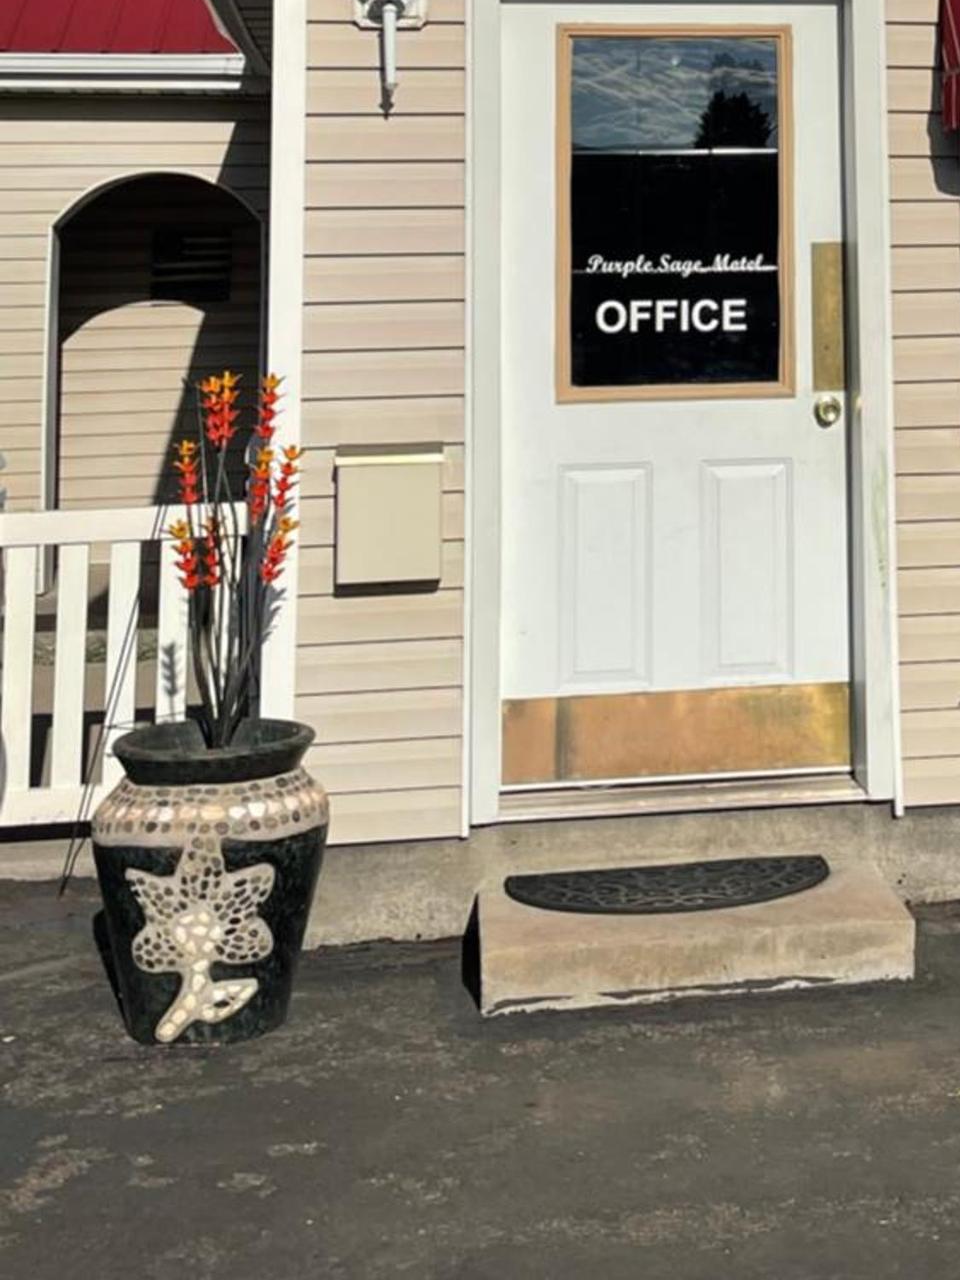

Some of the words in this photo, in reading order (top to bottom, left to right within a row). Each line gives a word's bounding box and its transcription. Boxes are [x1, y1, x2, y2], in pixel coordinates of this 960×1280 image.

[586, 254, 653, 278] Purple
[656, 253, 703, 278] Sage
[710, 253, 765, 272] Motel
[595, 298, 748, 334] OFFICE
